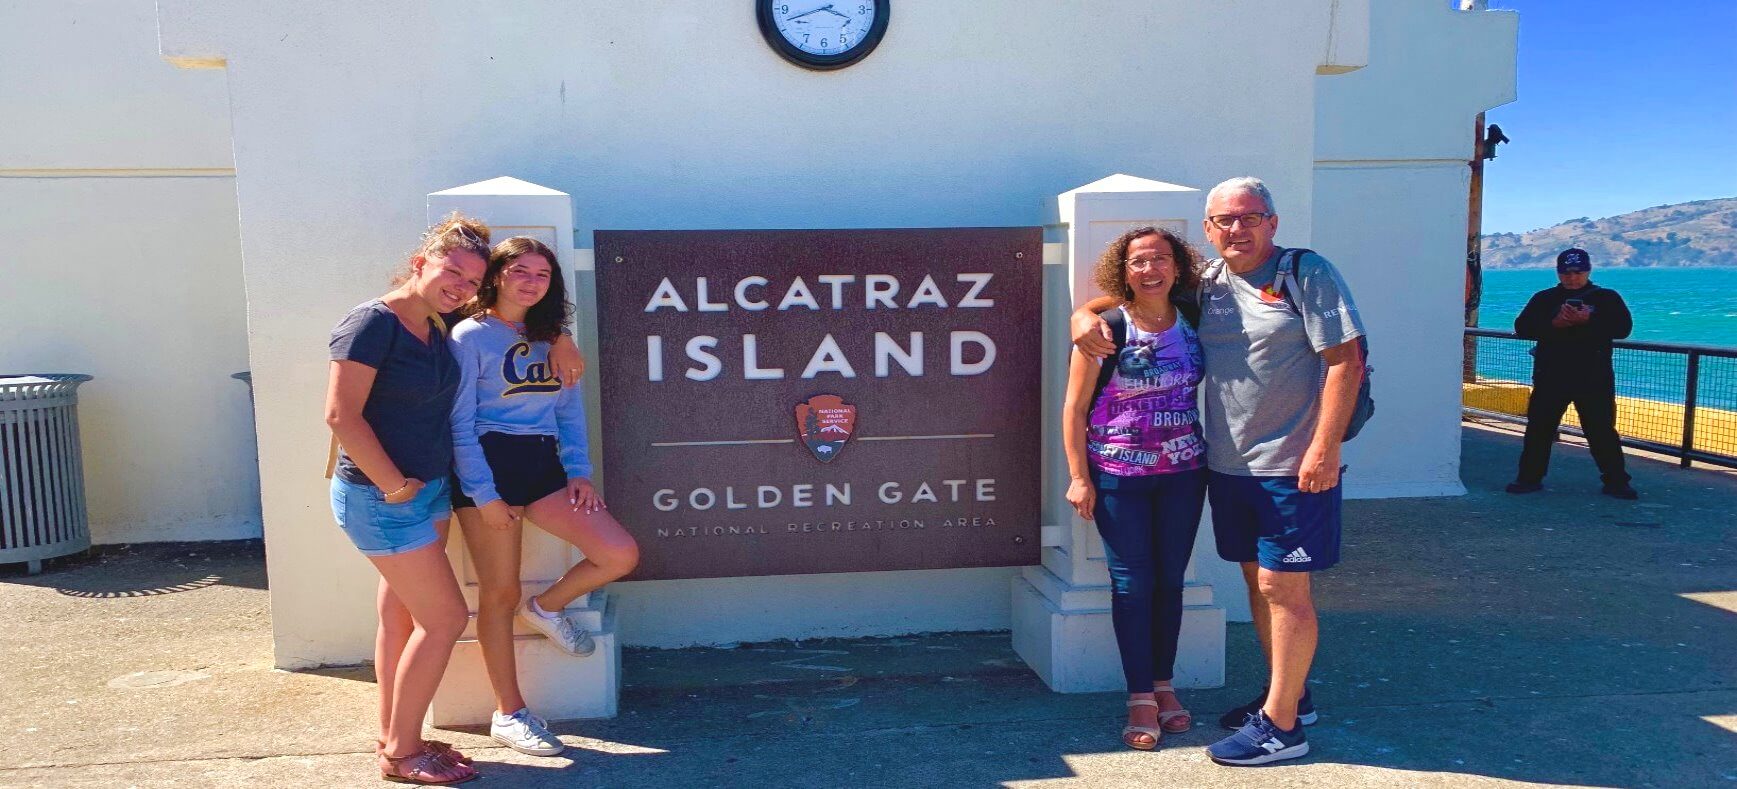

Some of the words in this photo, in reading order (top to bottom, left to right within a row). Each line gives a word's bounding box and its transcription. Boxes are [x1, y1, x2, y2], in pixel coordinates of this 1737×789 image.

[781, 4, 789, 15] 9
[857, 4, 866, 15] 3
[802, 33, 810, 43] 7
[820, 37, 828, 48] 6
[839, 33, 847, 43] 5
[644, 273, 995, 312] ALCATRAZ
[646, 330, 997, 382] ISLAND
[1143, 361, 1181, 377] BROADWAY
[1118, 449, 1158, 465] ISLAND
[652, 482, 852, 512] GOLDEN
[877, 479, 997, 504] GATE
[657, 525, 769, 538] NATIONAL
[787, 519, 925, 534] RECREATION
[942, 516, 997, 528] AREA
